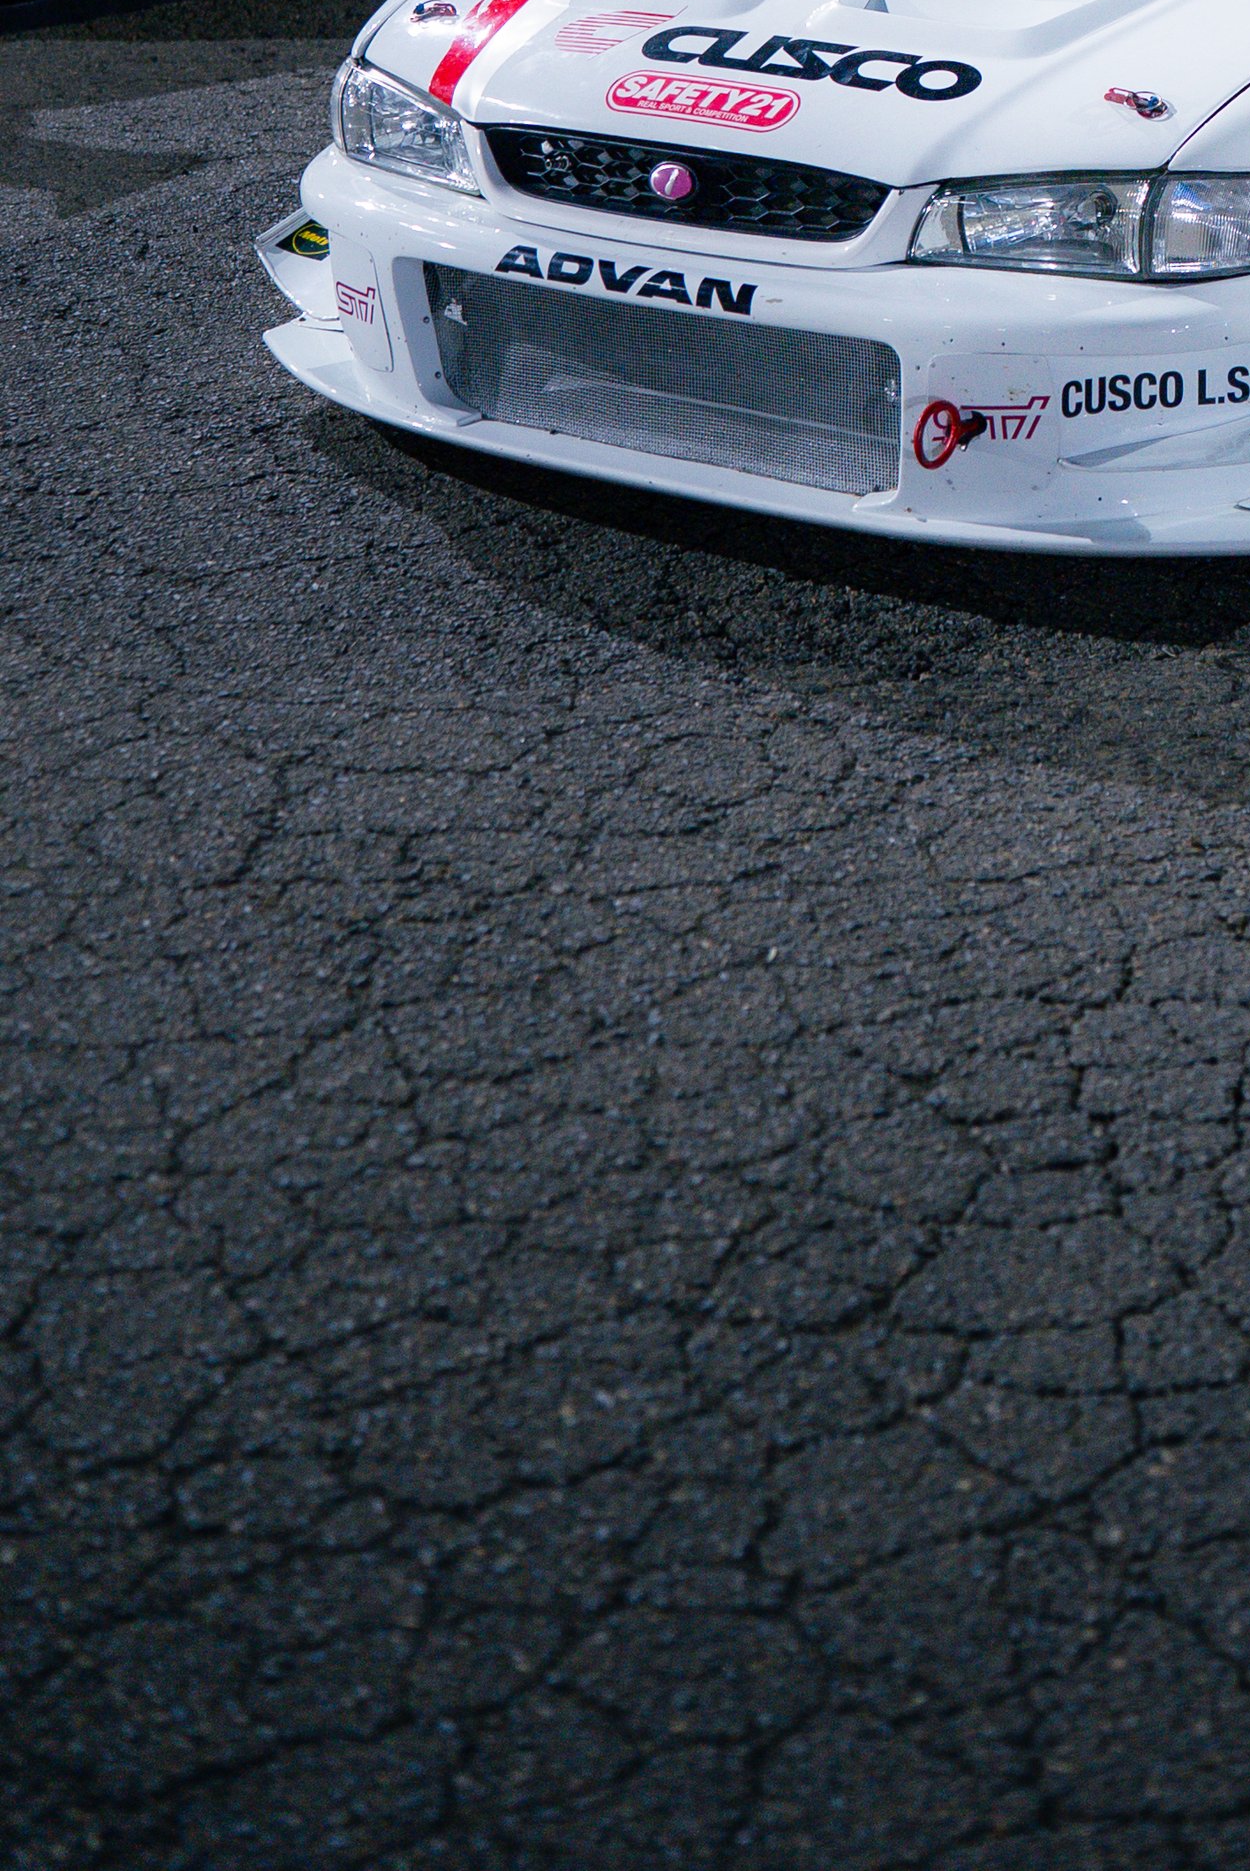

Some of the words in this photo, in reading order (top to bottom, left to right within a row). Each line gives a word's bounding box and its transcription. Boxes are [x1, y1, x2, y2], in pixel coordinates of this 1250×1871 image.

[641, 25, 983, 101] CUSCO
[637, 100, 658, 108] REAL
[658, 102, 685, 113] SPORT
[693, 107, 749, 122] COMPETITION
[495, 245, 758, 316] ADVAN
[1061, 370, 1184, 419] CUSCO
